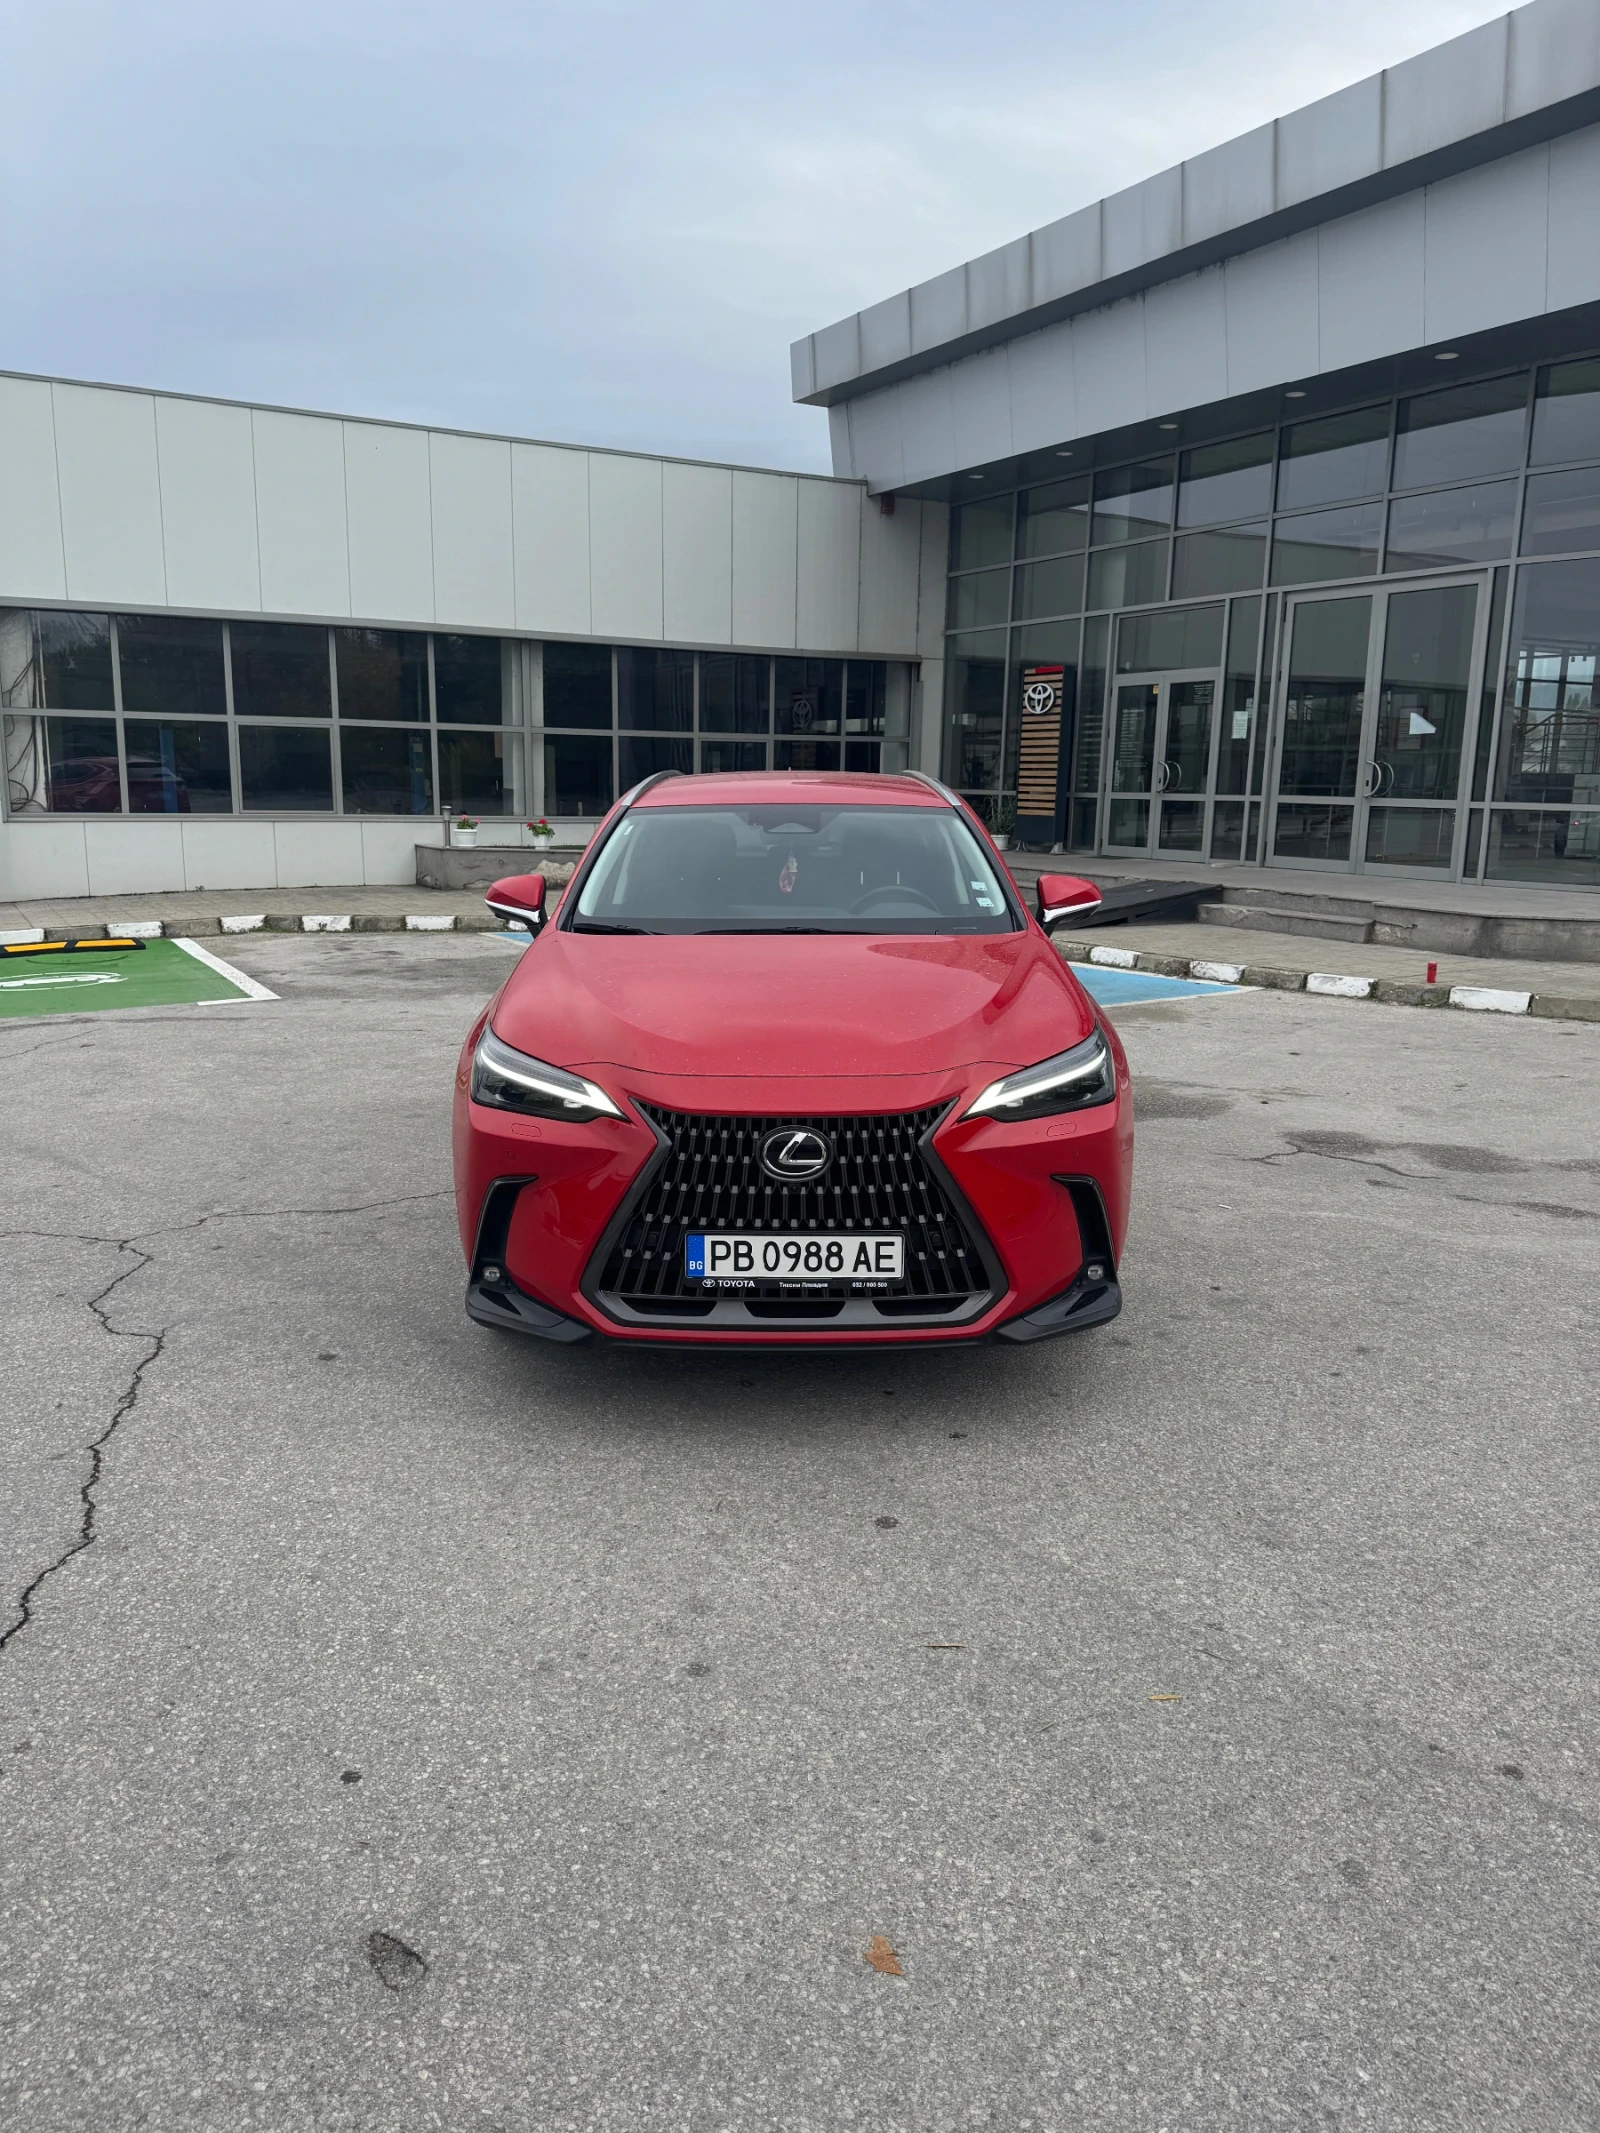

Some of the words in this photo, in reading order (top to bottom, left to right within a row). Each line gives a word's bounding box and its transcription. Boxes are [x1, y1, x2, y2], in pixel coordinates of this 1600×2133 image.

[710, 1240, 755, 1272] PB
[762, 1240, 844, 1273] 0988
[852, 1241, 896, 1273] AE
[689, 1260, 703, 1270] BG
[717, 1279, 756, 1288] TOYOTA
